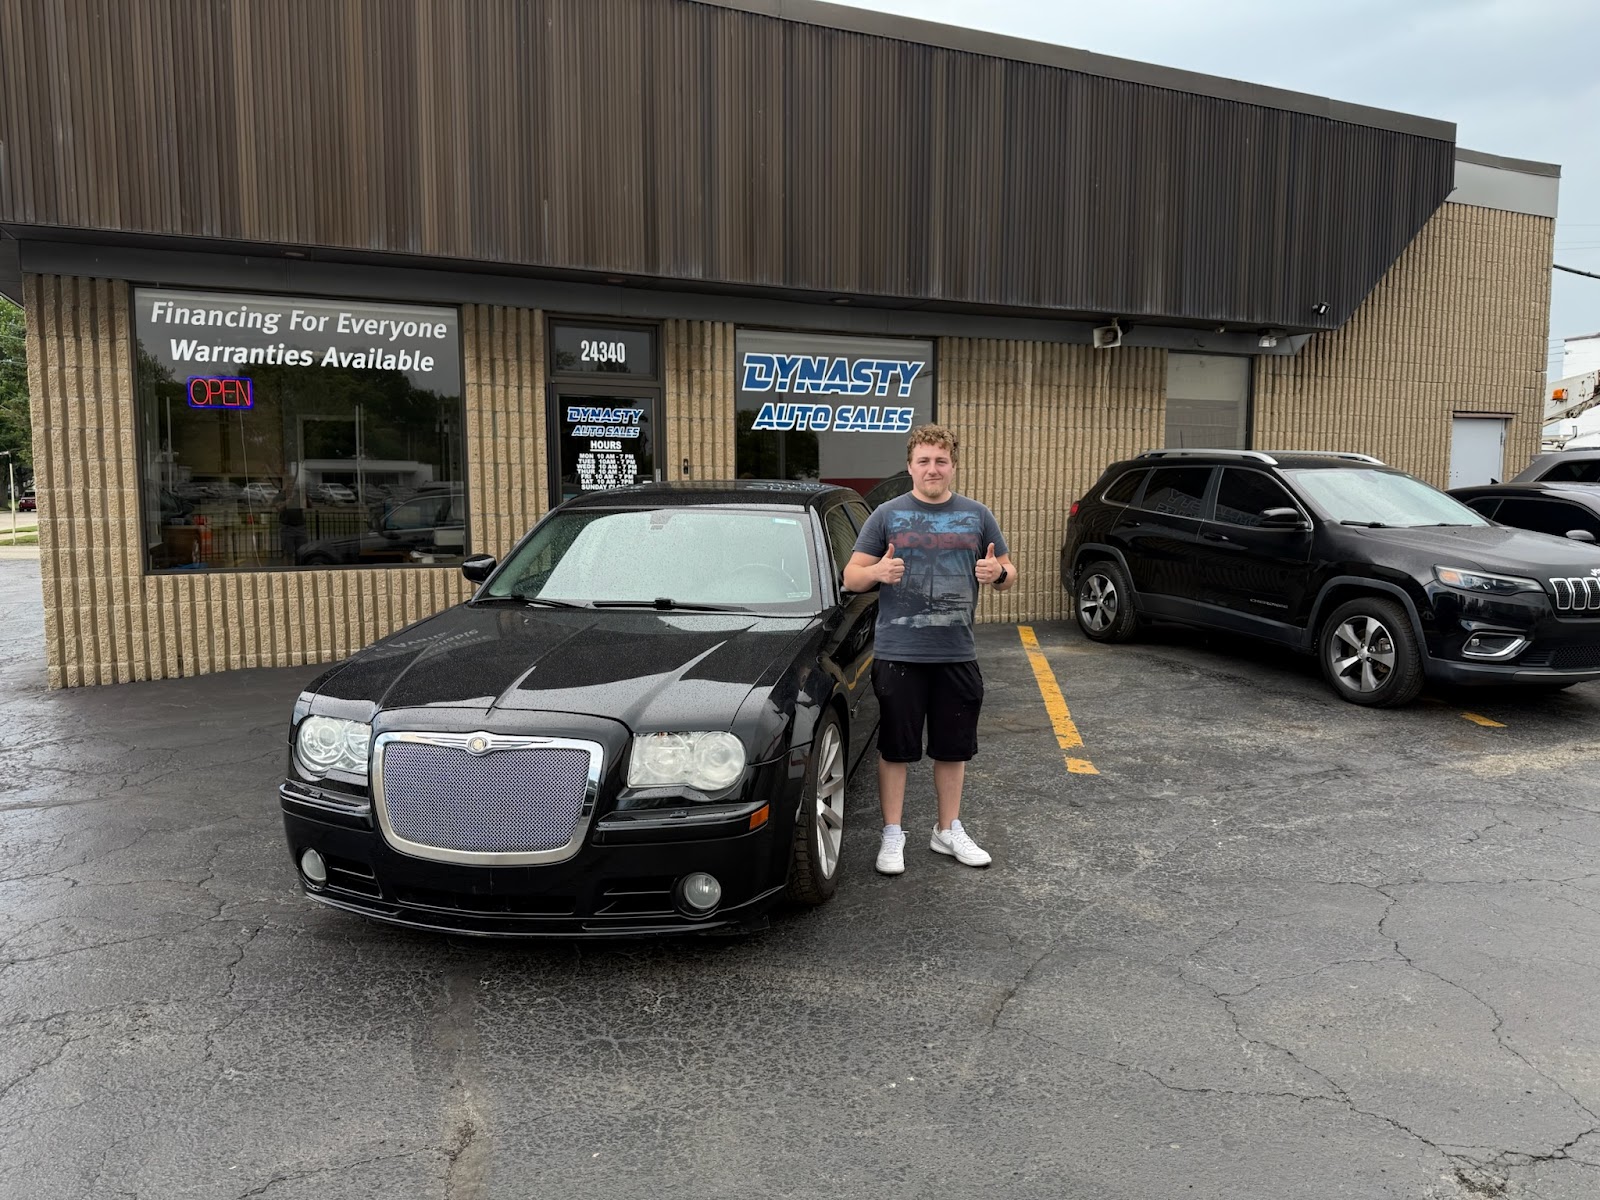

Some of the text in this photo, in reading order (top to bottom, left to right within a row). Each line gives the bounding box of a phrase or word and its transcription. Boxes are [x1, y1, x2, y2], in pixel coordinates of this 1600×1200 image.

[151, 301, 447, 341] Financing For Everyone
[170, 339, 434, 372] Warranties Available
[580, 340, 626, 363] 24340
[742, 353, 925, 397] DYNASTY
[189, 378, 251, 407] OPEN
[567, 406, 644, 424] DYNASTY
[751, 403, 914, 434] AUTO SALES
[571, 425, 640, 438] AUTO SALES
[590, 440, 622, 450] HOURS
